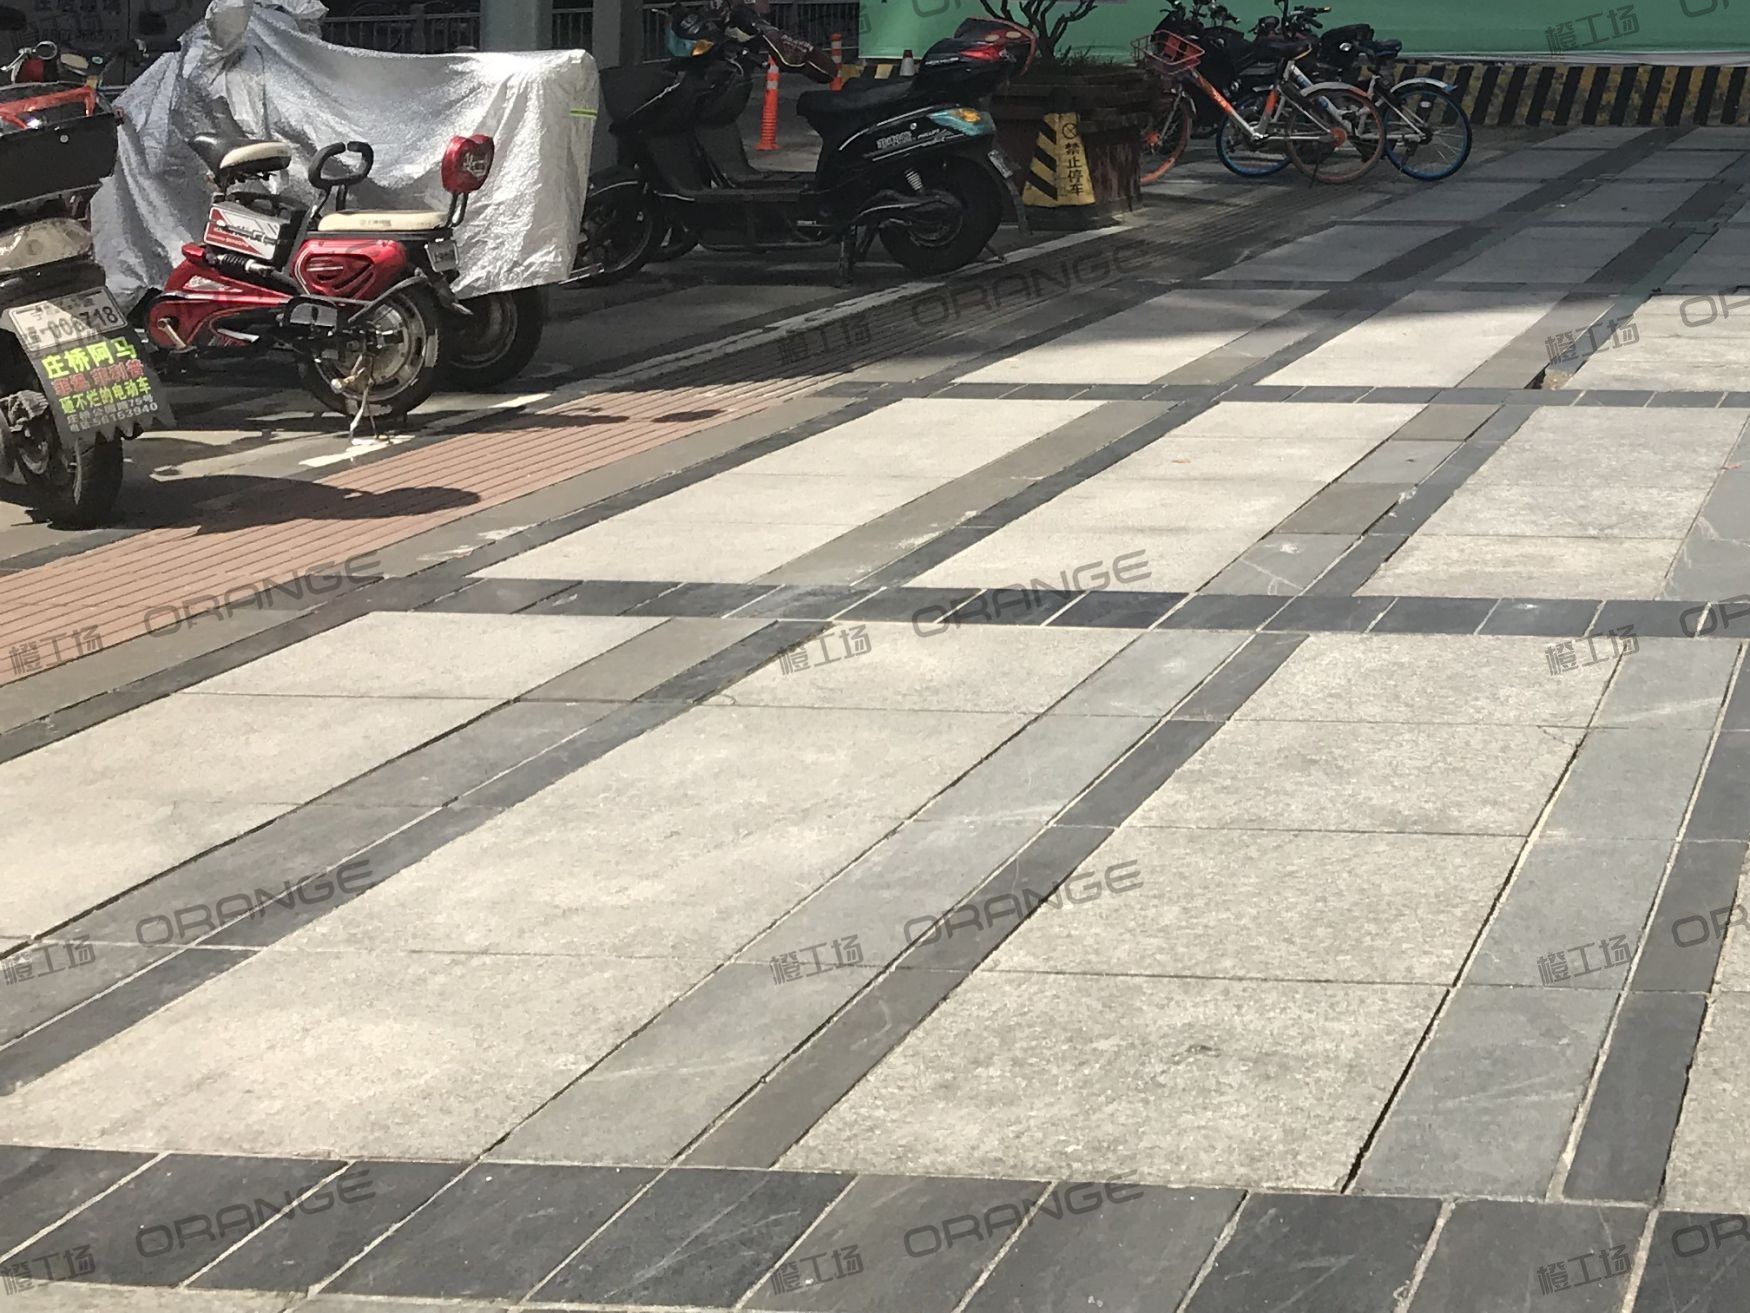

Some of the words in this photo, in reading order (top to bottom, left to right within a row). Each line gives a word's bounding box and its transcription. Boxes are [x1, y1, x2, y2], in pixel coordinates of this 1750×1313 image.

[1064, 142, 1084, 196] 禁止停车
[41, 336, 137, 379] 庄桥阿马
